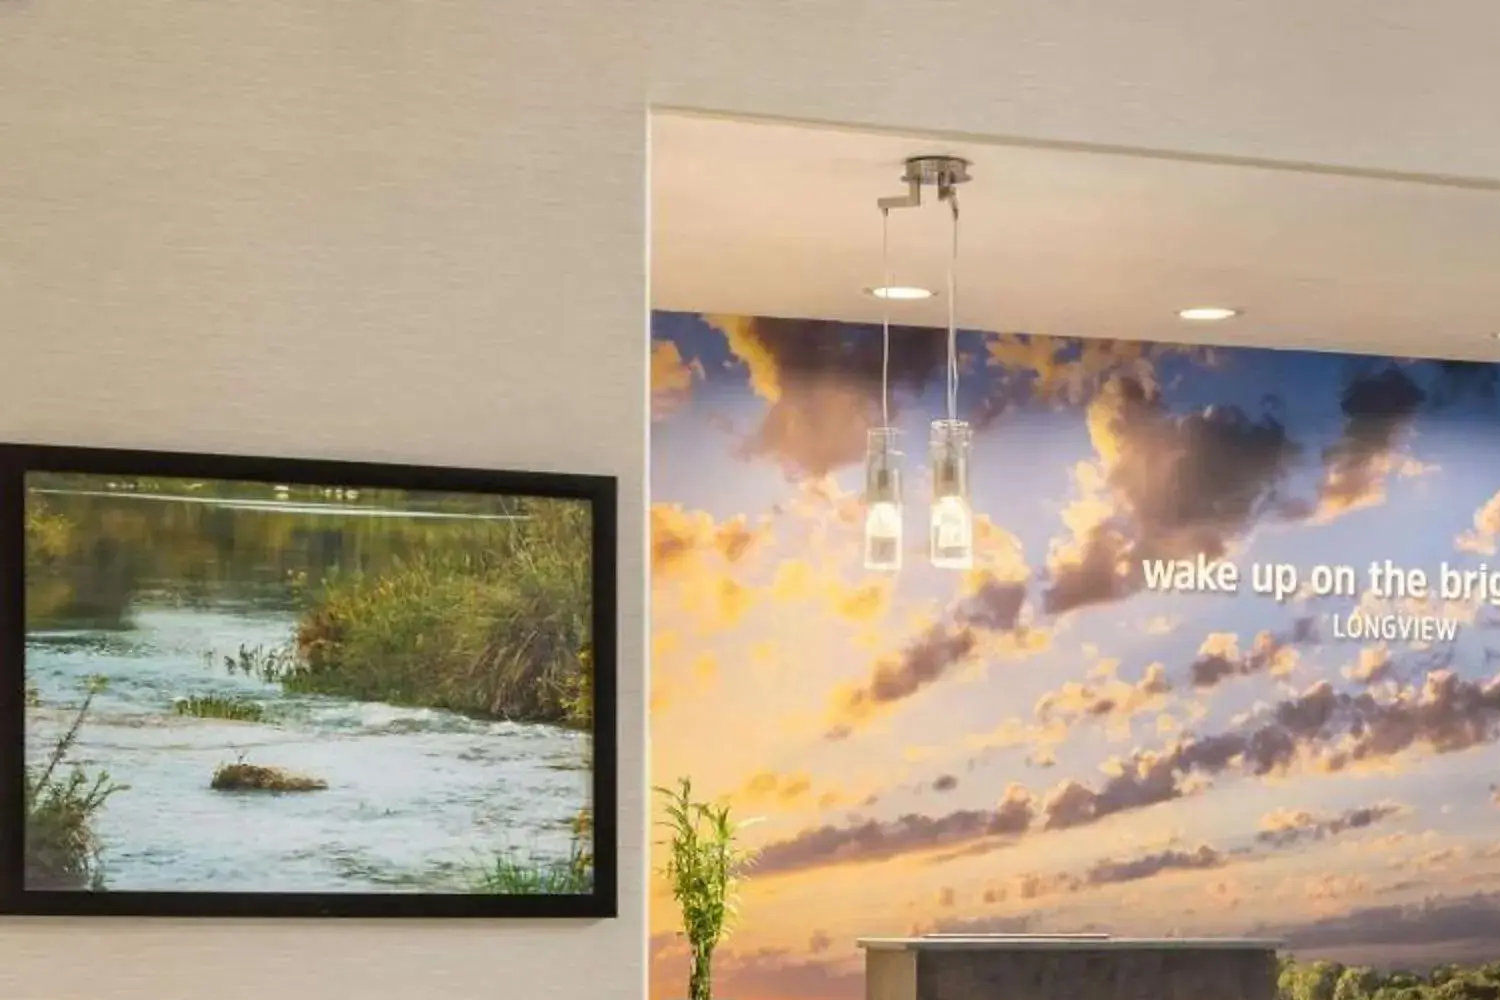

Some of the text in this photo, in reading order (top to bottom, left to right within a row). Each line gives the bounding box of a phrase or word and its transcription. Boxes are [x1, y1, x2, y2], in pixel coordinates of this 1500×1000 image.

[1142, 553, 1239, 592] wake
[1252, 562, 1298, 601] up
[1311, 564, 1356, 596] on
[1368, 559, 1428, 598] the
[1332, 612, 1458, 641] LONGVIEW
